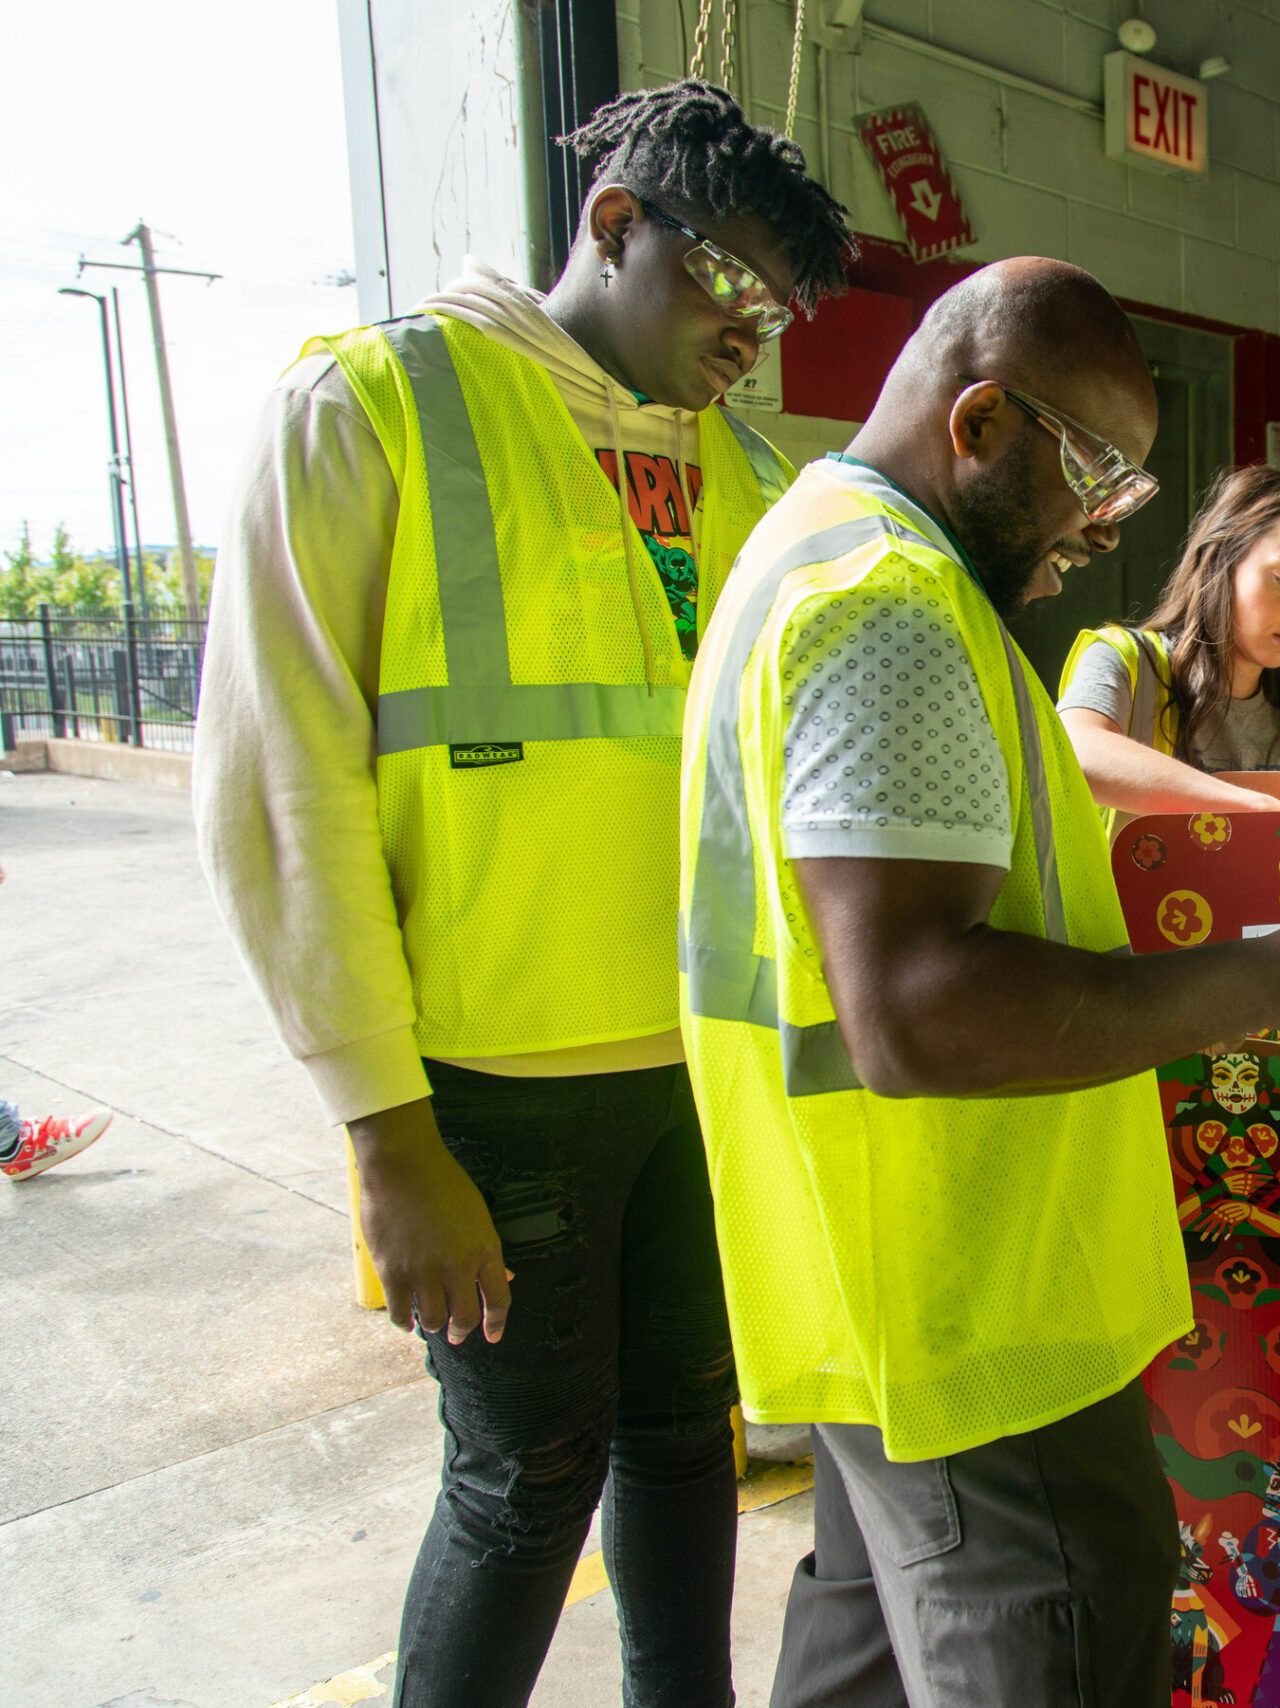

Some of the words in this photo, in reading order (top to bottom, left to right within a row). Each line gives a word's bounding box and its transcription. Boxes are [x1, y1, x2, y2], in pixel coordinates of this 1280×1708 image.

[1133, 73, 1198, 161] EXIT
[876, 126, 921, 155] FIRE
[458, 751, 514, 759] RADWEAR
